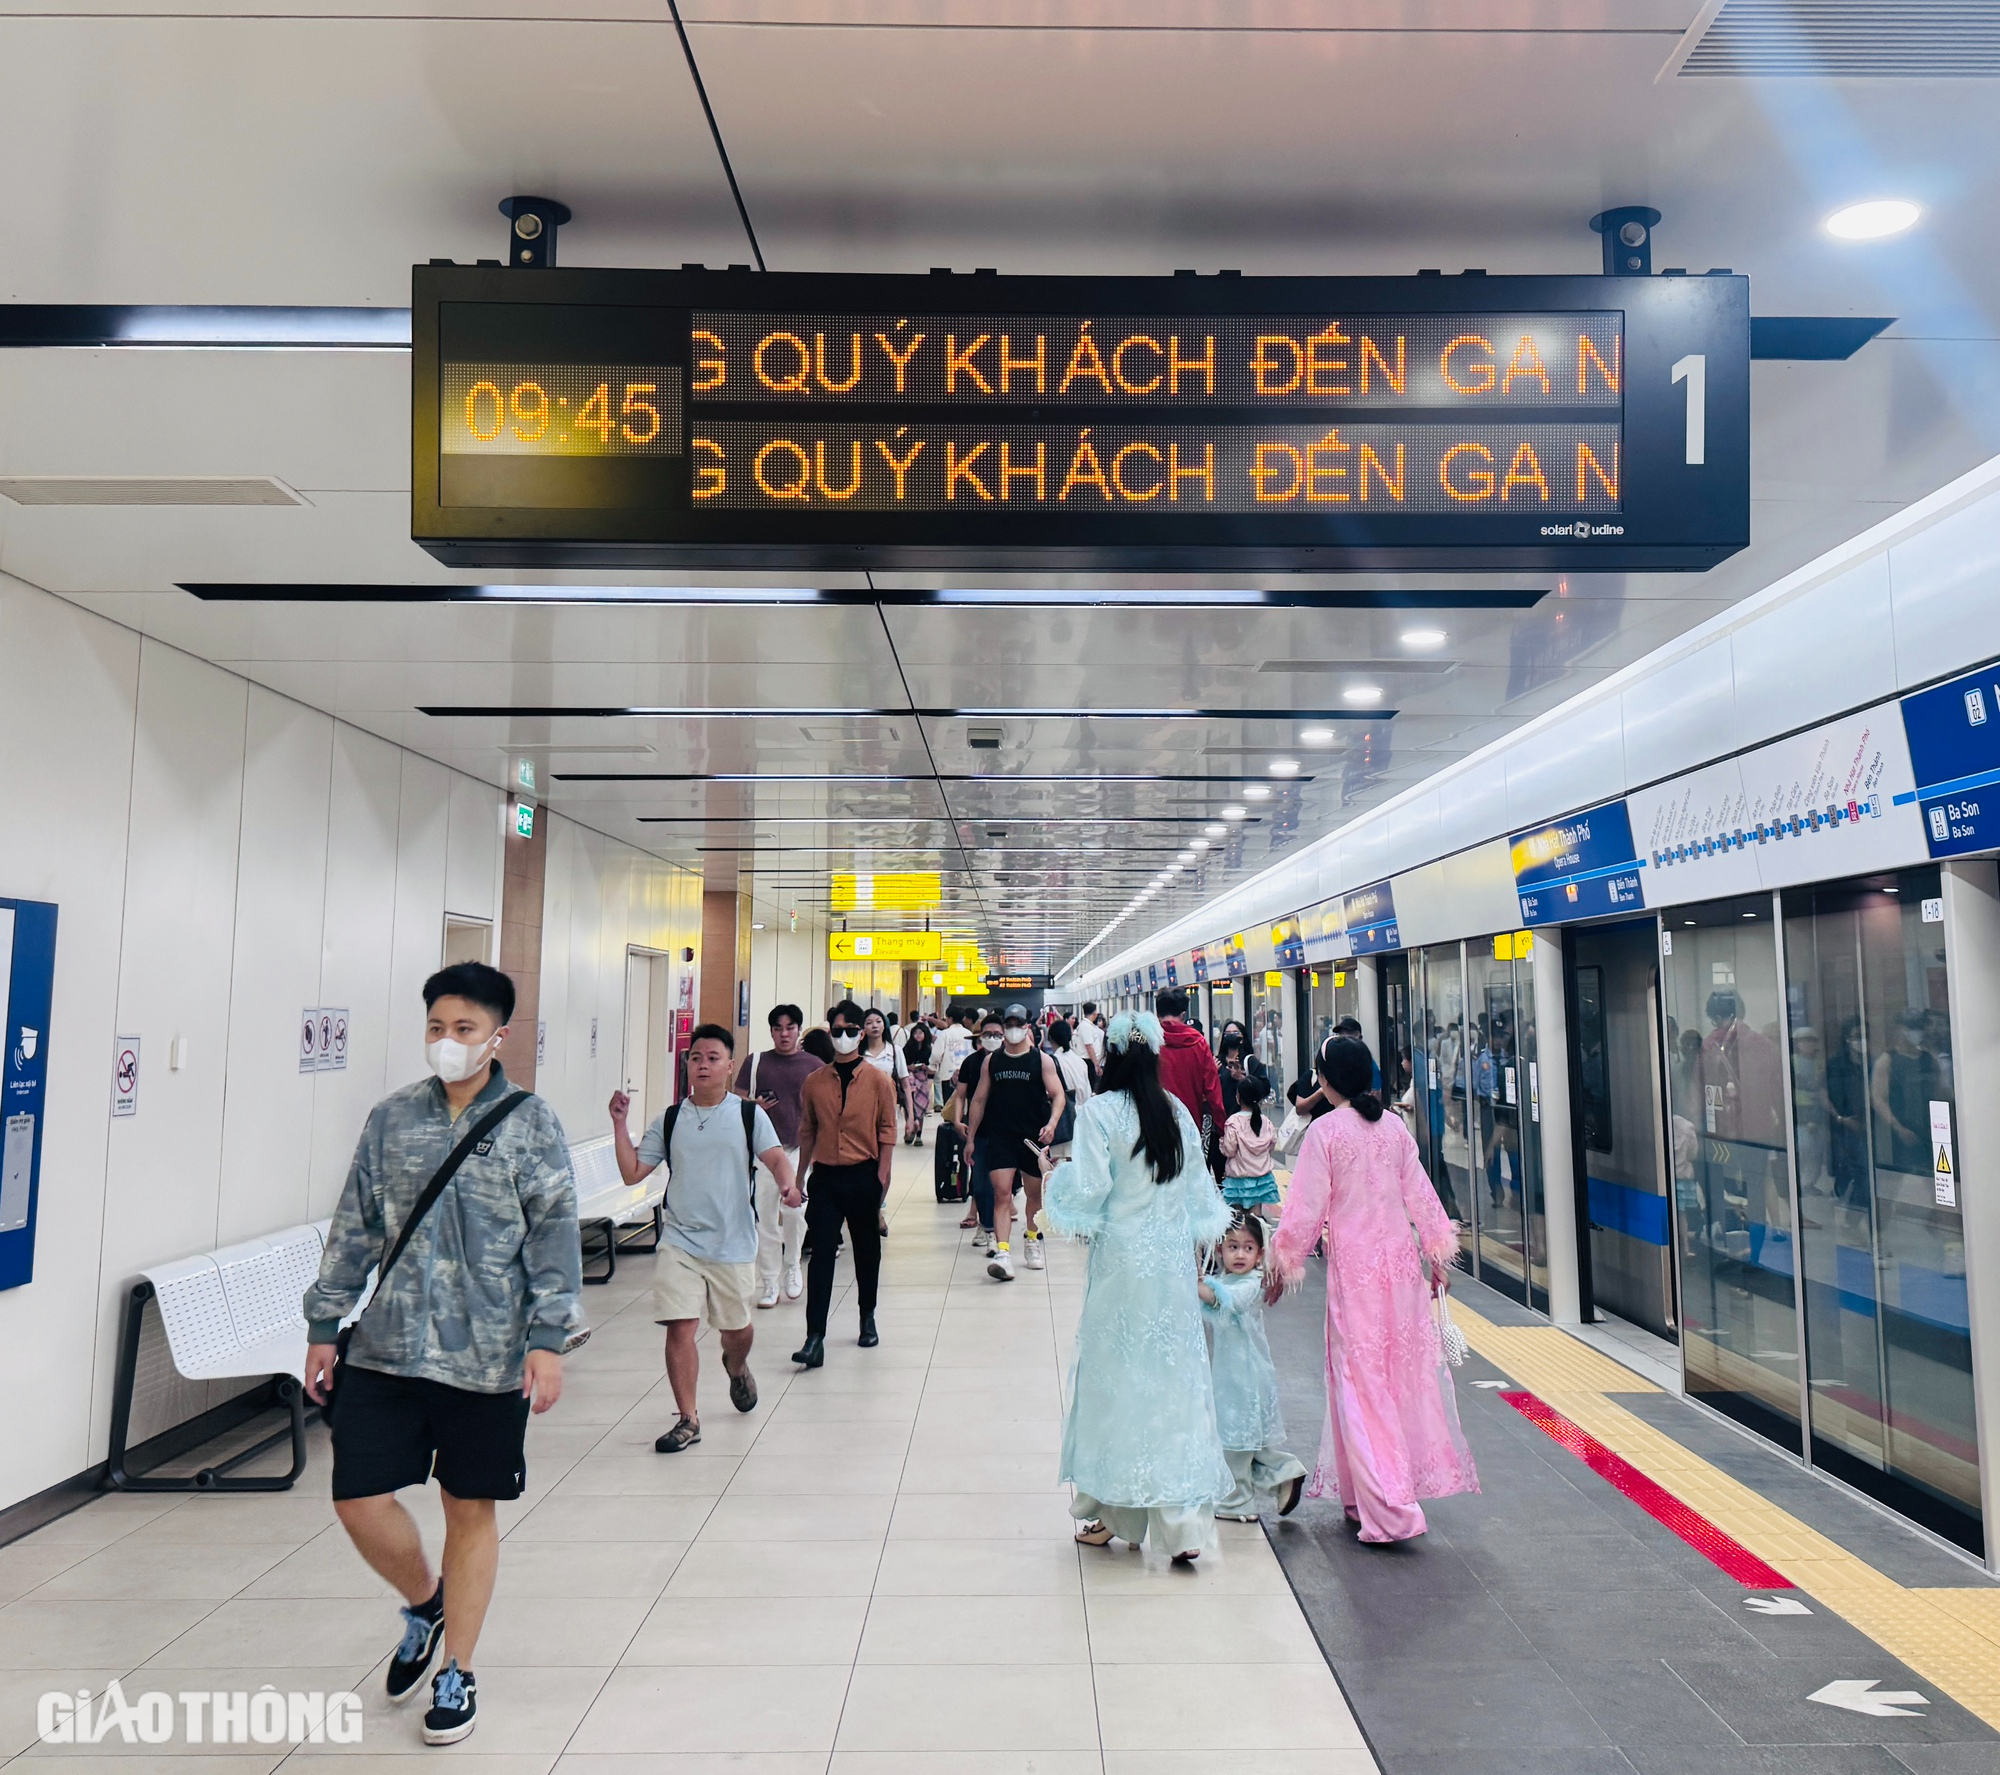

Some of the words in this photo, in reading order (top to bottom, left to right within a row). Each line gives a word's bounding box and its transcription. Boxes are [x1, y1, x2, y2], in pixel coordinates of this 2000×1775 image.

[755, 319, 924, 394] QUÝ
[947, 321, 1215, 395] KHÁCH
[1440, 335, 1551, 395] GA
[1578, 335, 1619, 394] N
[463, 380, 661, 445] 09:45
[1671, 354, 1706, 465] 1
[755, 427, 926, 502] QUÝ
[947, 429, 1214, 502] KHÁCH
[1440, 442, 1549, 502] GA
[1577, 442, 1618, 501] N
[1540, 524, 1573, 536] solari
[1591, 524, 1625, 536] udine
[1969, 694, 1979, 707] L1
[1972, 707, 1982, 720] 02
[1947, 804, 1961, 821] Ba
[1961, 800, 1981, 818] Son
[1558, 826, 1578, 847] Thành
[1576, 819, 1591, 842] Phố
[1952, 825, 1962, 838] Ba
[1962, 824, 1975, 837] Son
[1565, 853, 1580, 866] House
[1924, 901, 1941, 920] 1-18
[875, 936, 904, 947] Thang
[906, 936, 926, 947] máy
